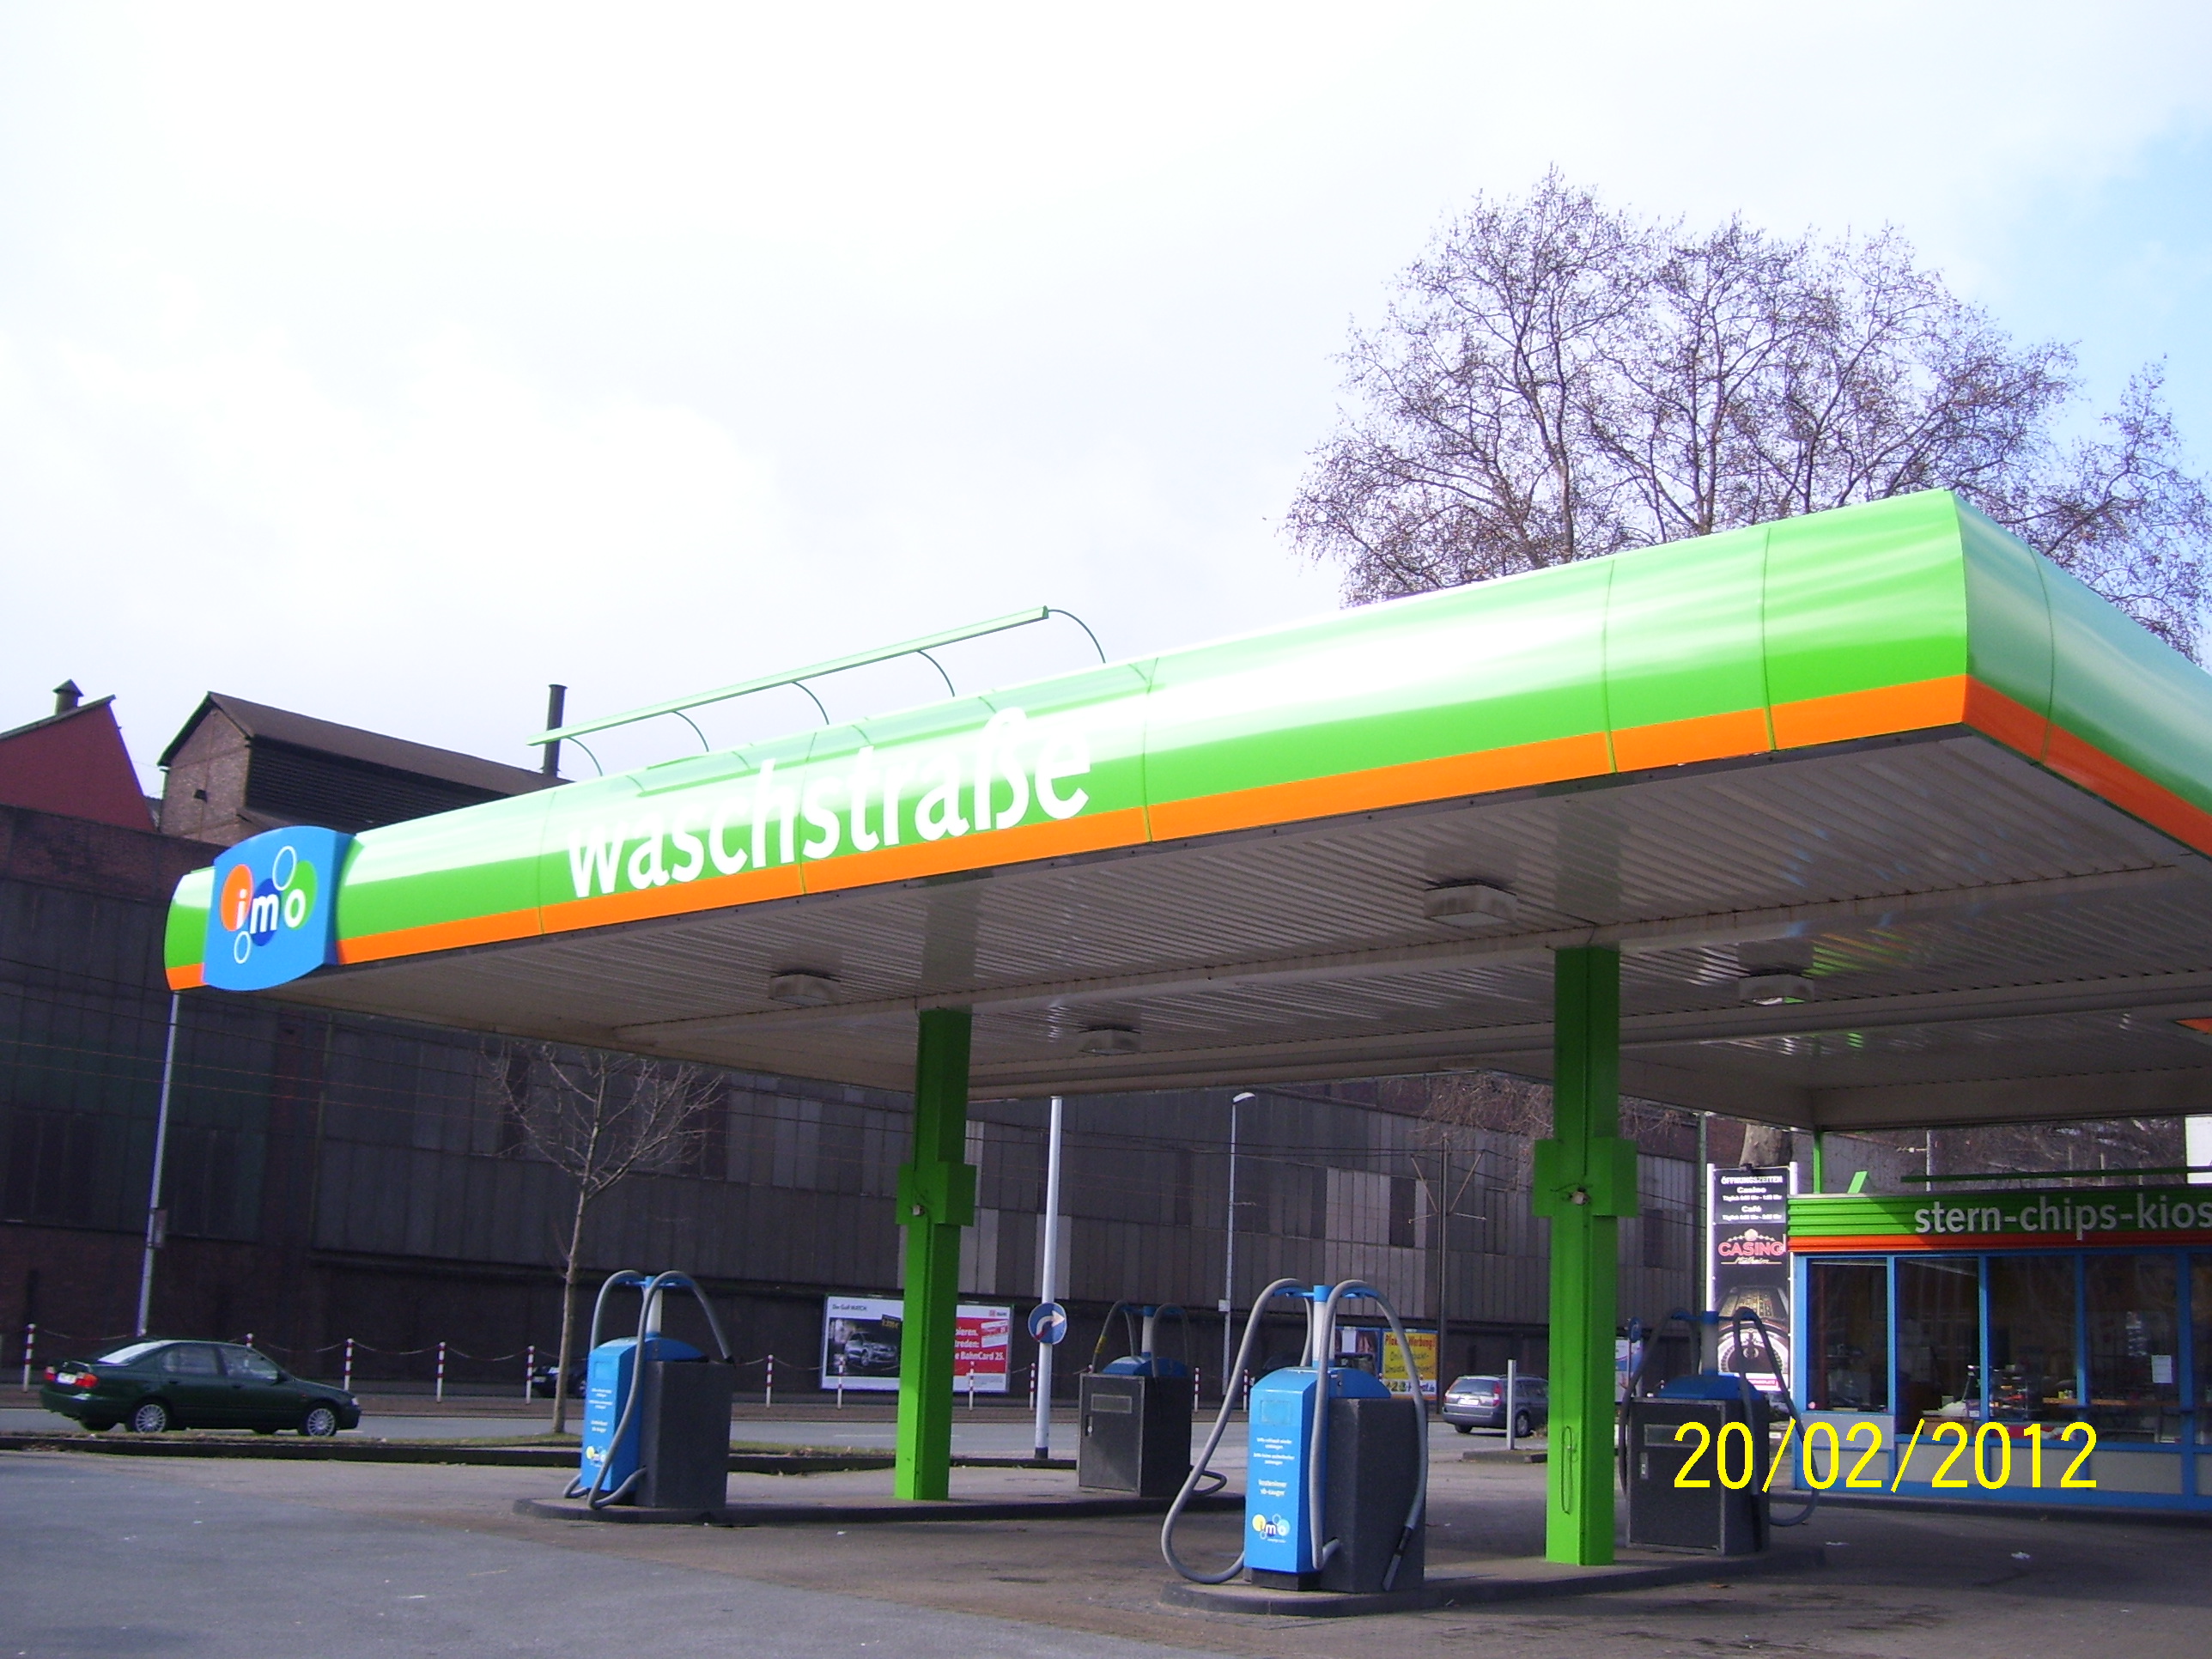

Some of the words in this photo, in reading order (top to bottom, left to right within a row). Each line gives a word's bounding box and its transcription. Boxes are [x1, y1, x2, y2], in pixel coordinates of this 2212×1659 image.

[566, 707, 1091, 899] waschstraße
[235, 888, 307, 934] imo
[1717, 1241, 1784, 1257] CASINO
[960, 1351, 994, 1361] BahnCard
